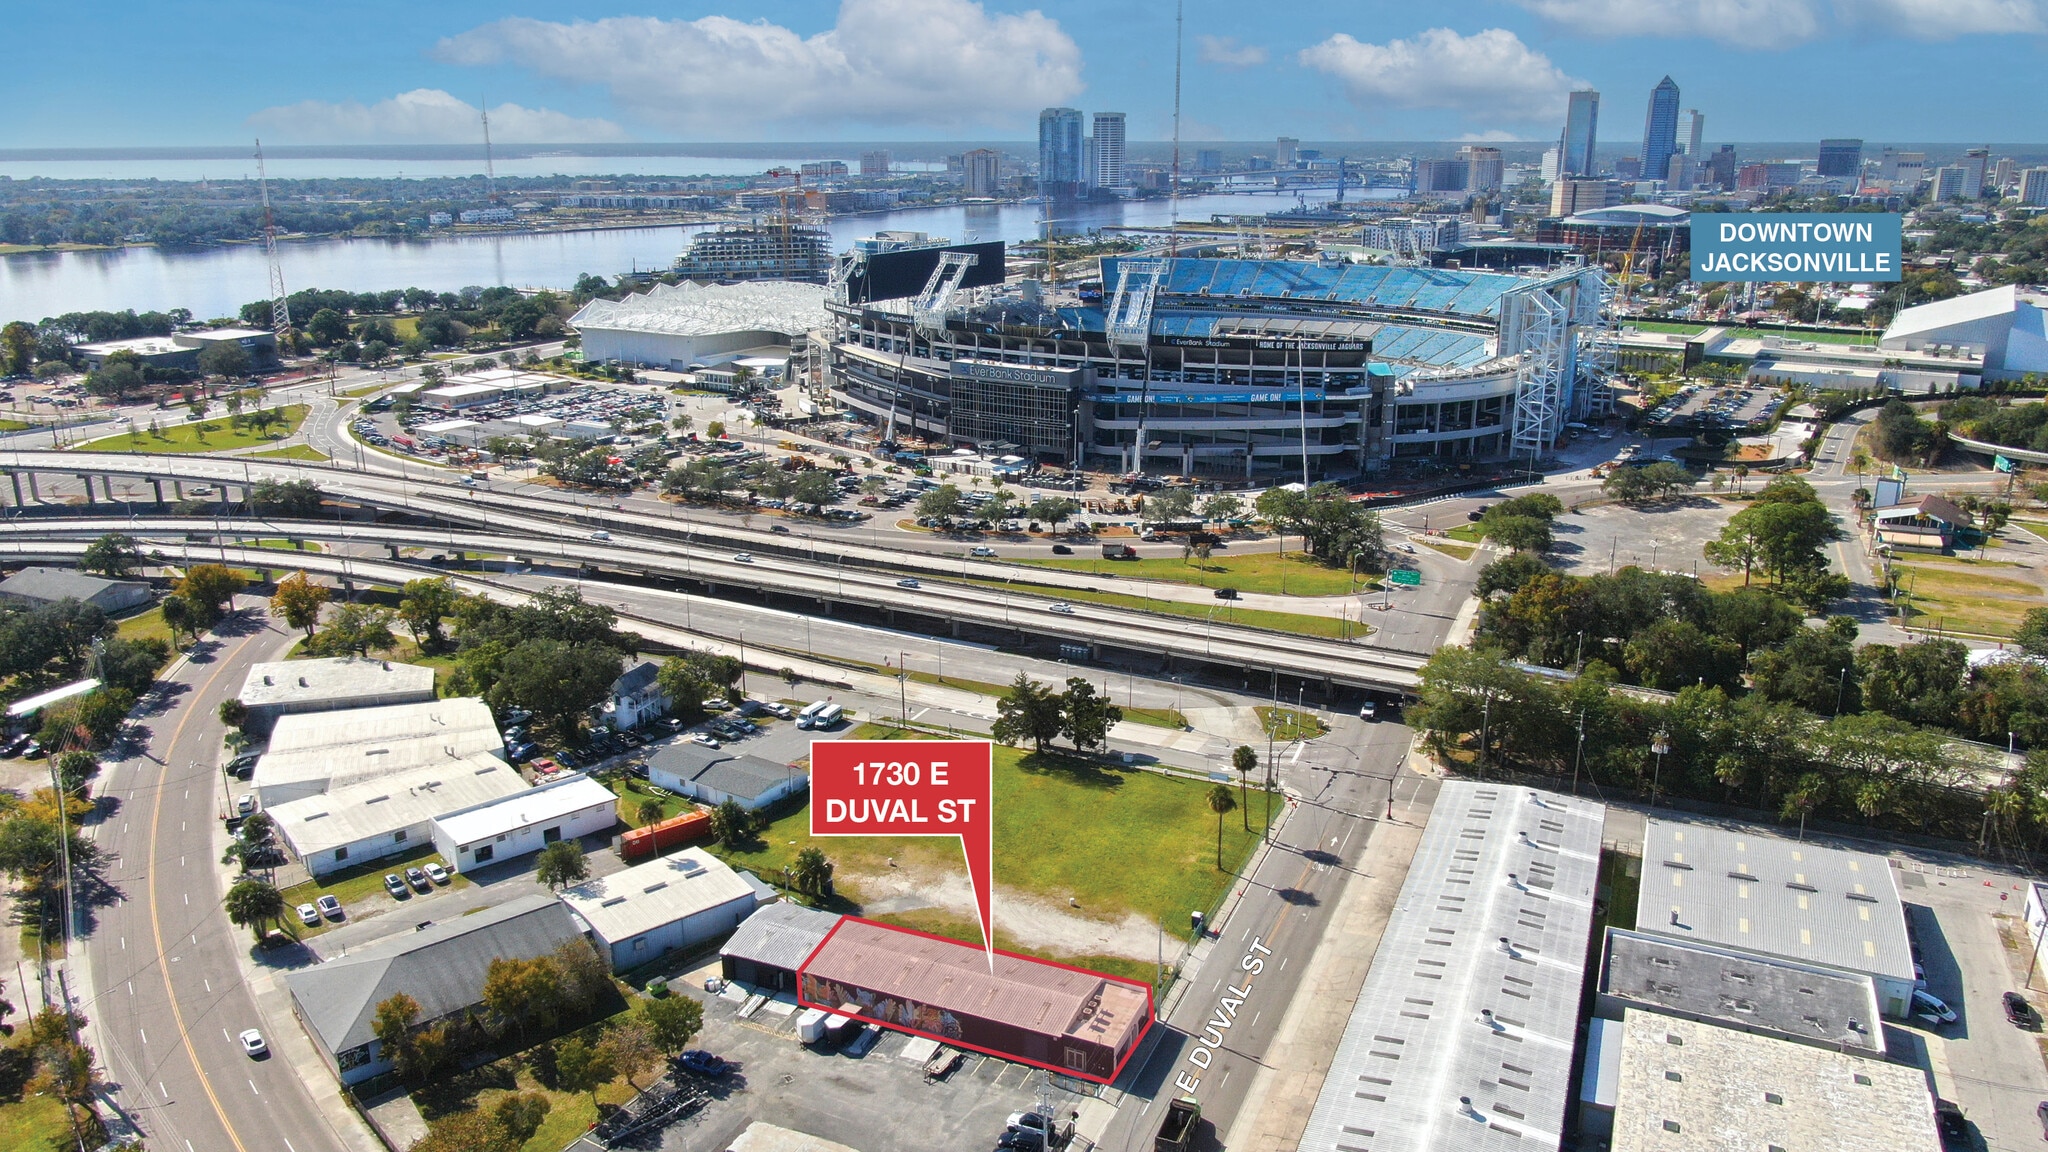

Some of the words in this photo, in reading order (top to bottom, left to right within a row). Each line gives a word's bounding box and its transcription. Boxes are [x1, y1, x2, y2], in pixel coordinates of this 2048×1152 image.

[1259, 341, 1274, 349] HOME
[969, 365, 1012, 379] EverBank
[1014, 372, 1056, 384] Stadium
[1126, 394, 1143, 403] GAME
[1250, 394, 1268, 402] GAME
[1270, 393, 1281, 402] ON!
